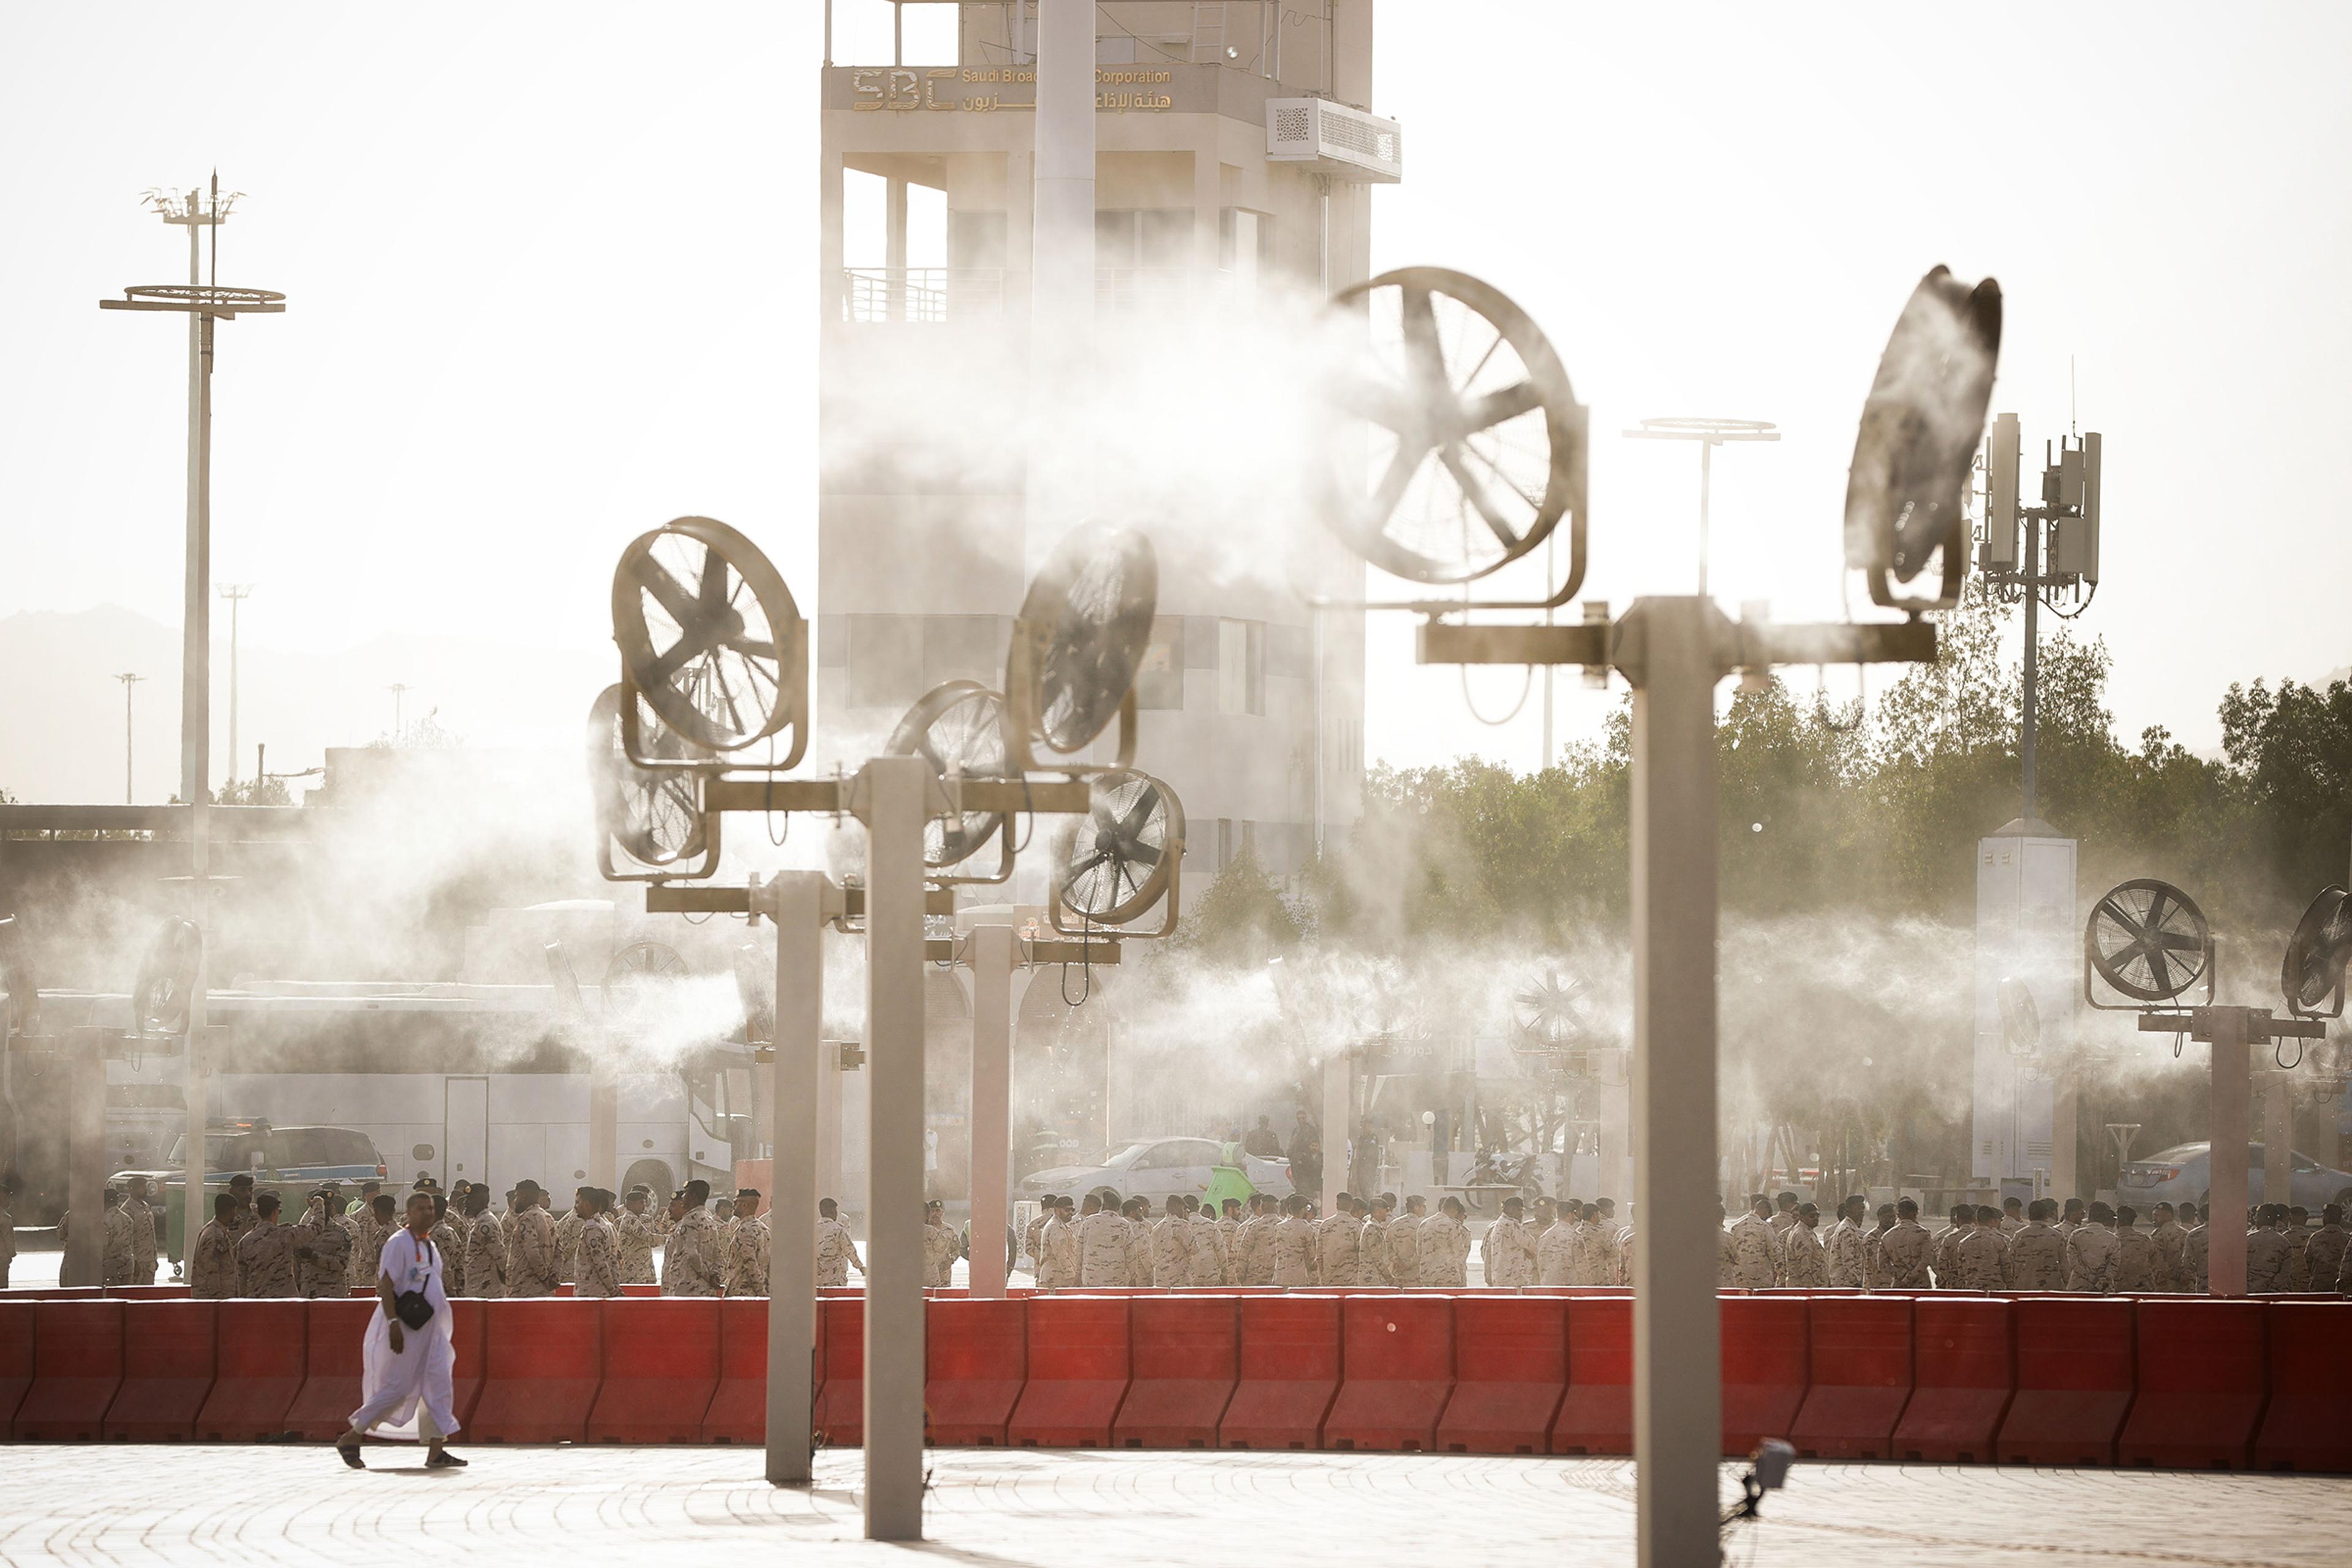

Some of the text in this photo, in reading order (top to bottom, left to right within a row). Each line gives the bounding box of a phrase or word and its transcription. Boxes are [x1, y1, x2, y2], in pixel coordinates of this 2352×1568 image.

[962, 69, 999, 83] Saudi
[1095, 69, 1170, 85] Corporation
[853, 69, 957, 111] SBC
[1096, 90, 1171, 113] هيئة الإذاع
